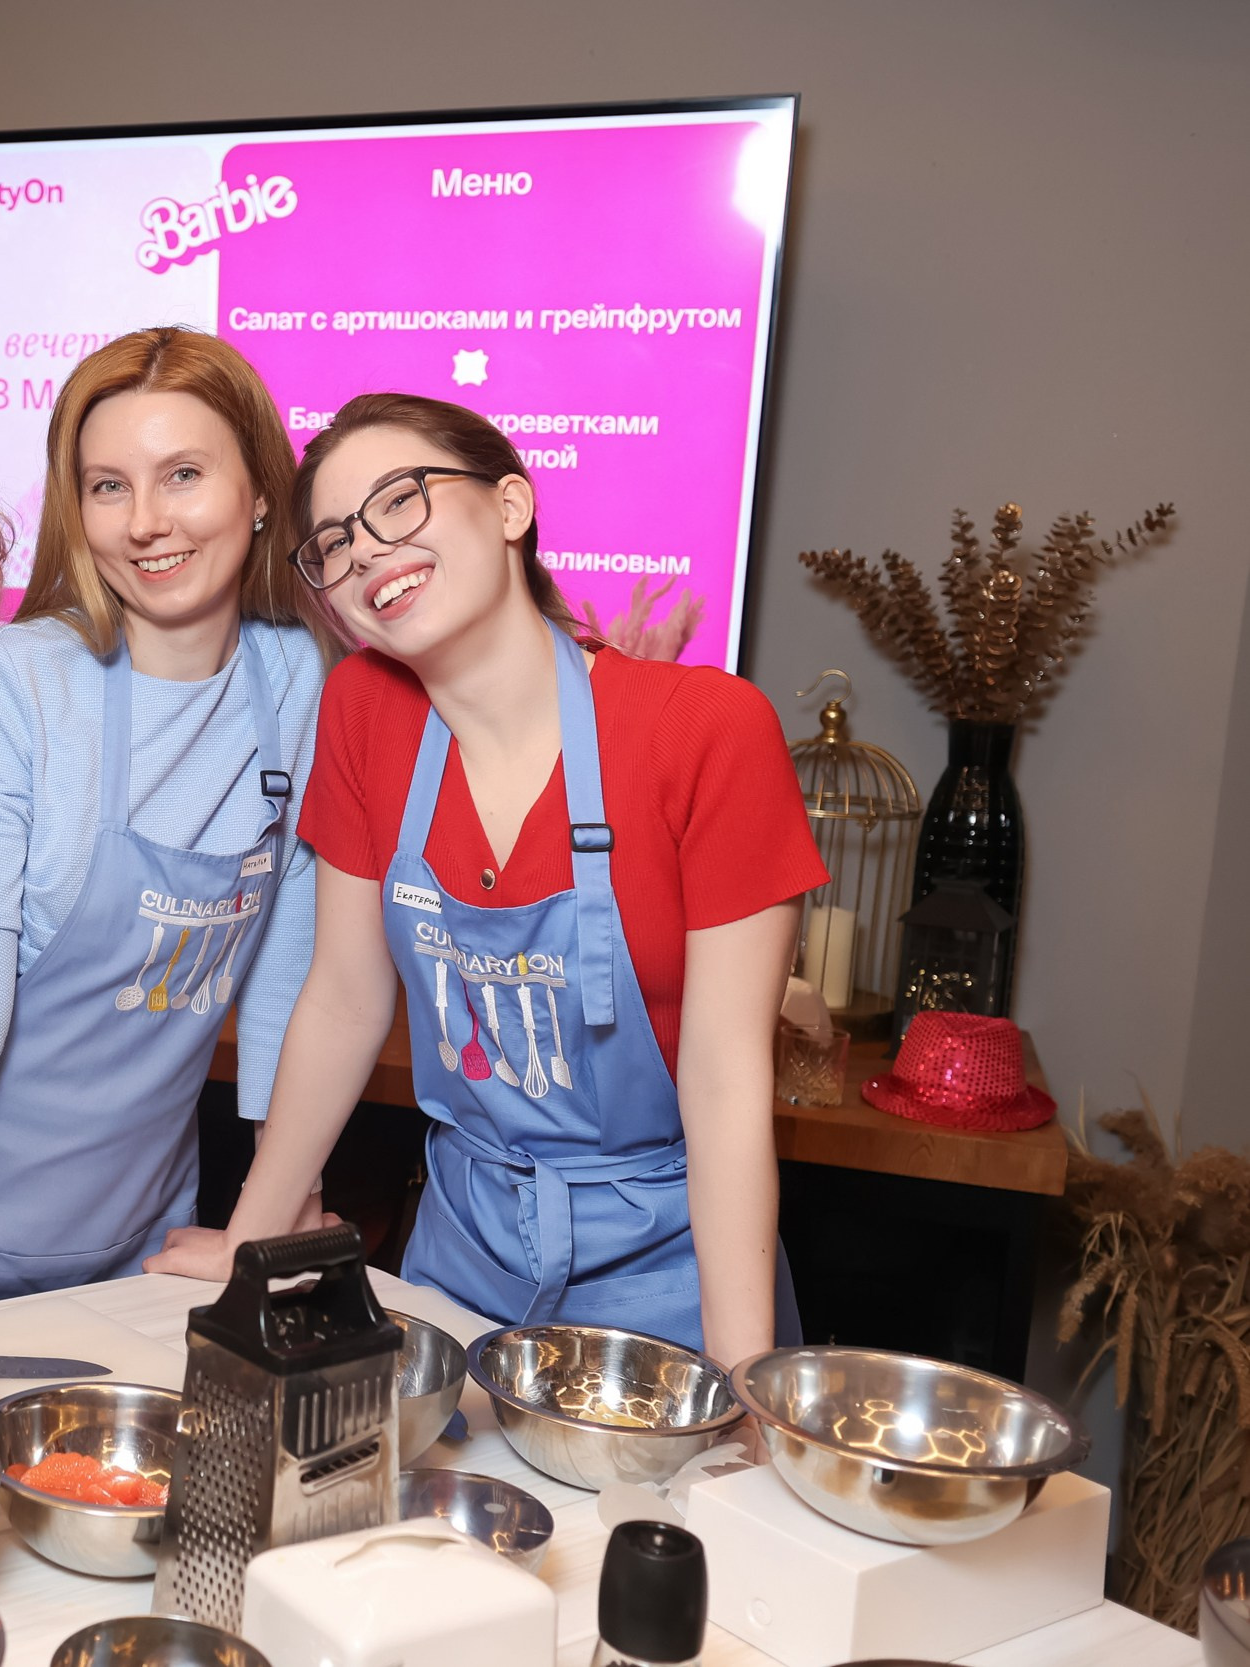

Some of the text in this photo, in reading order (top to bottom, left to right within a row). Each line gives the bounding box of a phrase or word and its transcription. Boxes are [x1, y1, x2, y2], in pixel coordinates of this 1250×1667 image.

[431, 167, 533, 199] Меню
[137, 173, 299, 270] Barbie
[228, 303, 743, 335] Салат с артишоками и грейпфрутом
